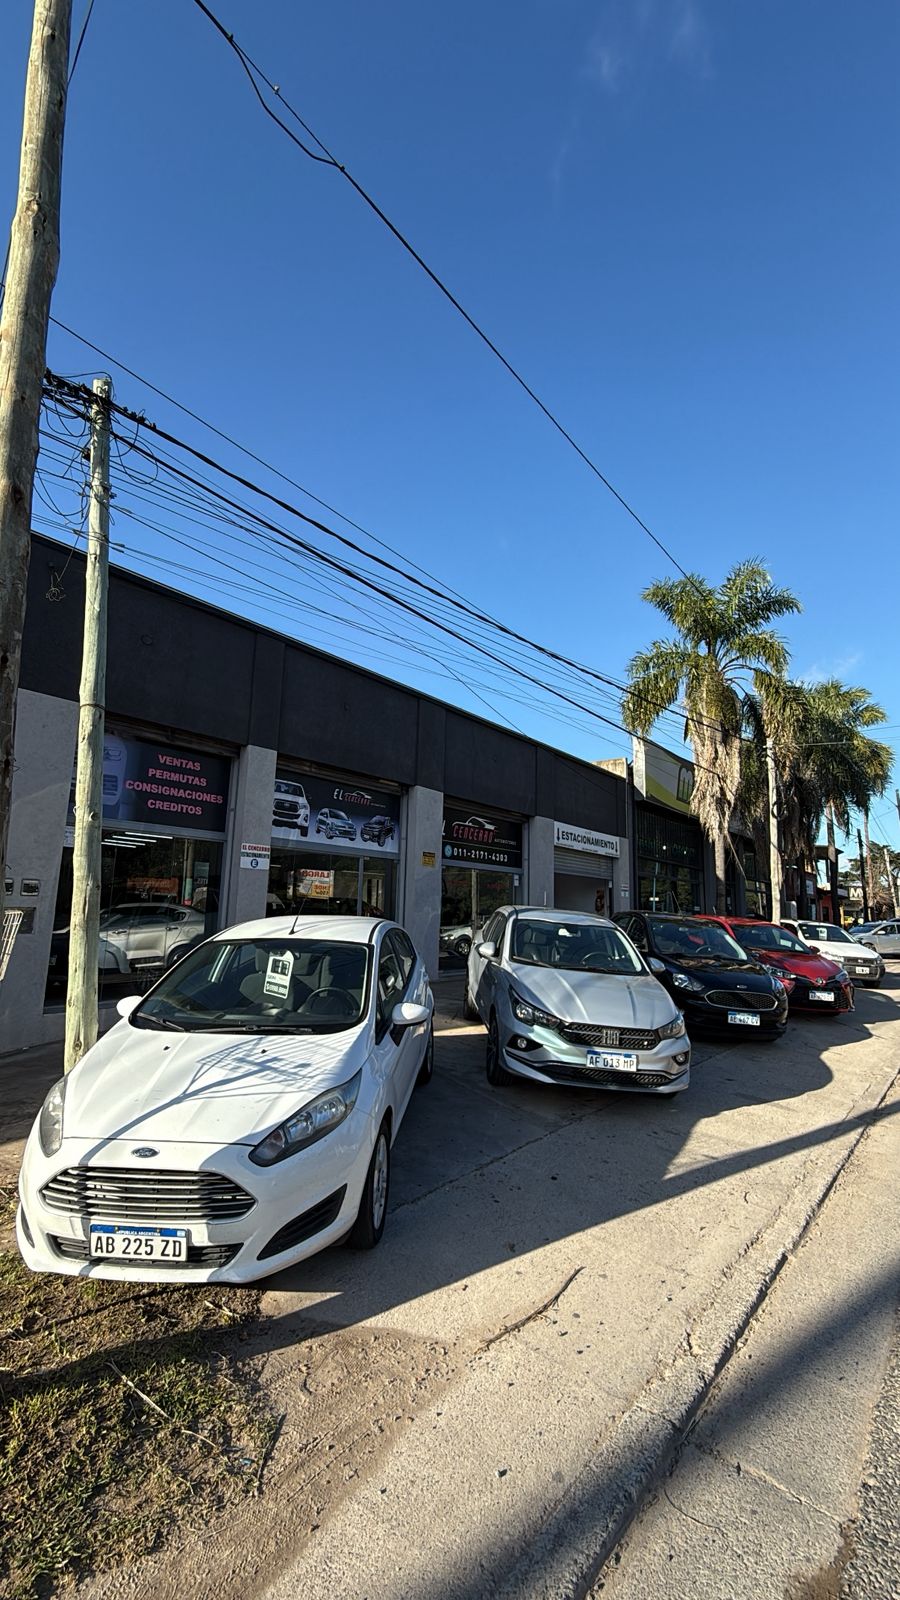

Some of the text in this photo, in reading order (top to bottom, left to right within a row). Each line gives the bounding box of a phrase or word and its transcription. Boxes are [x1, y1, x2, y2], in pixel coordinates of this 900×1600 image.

[158, 754, 201, 771] VENTAS
[147, 768, 207, 787] PERMUTAS
[125, 780, 224, 804] CONSIGNACIONES
[333, 788, 344, 801] EL
[147, 799, 203, 815] CREDITOS
[561, 830, 615, 851] ESTACIONAMIENTO
[589, 1056, 600, 1066] AF
[94, 1236, 182, 1258] AB 225 ZD
